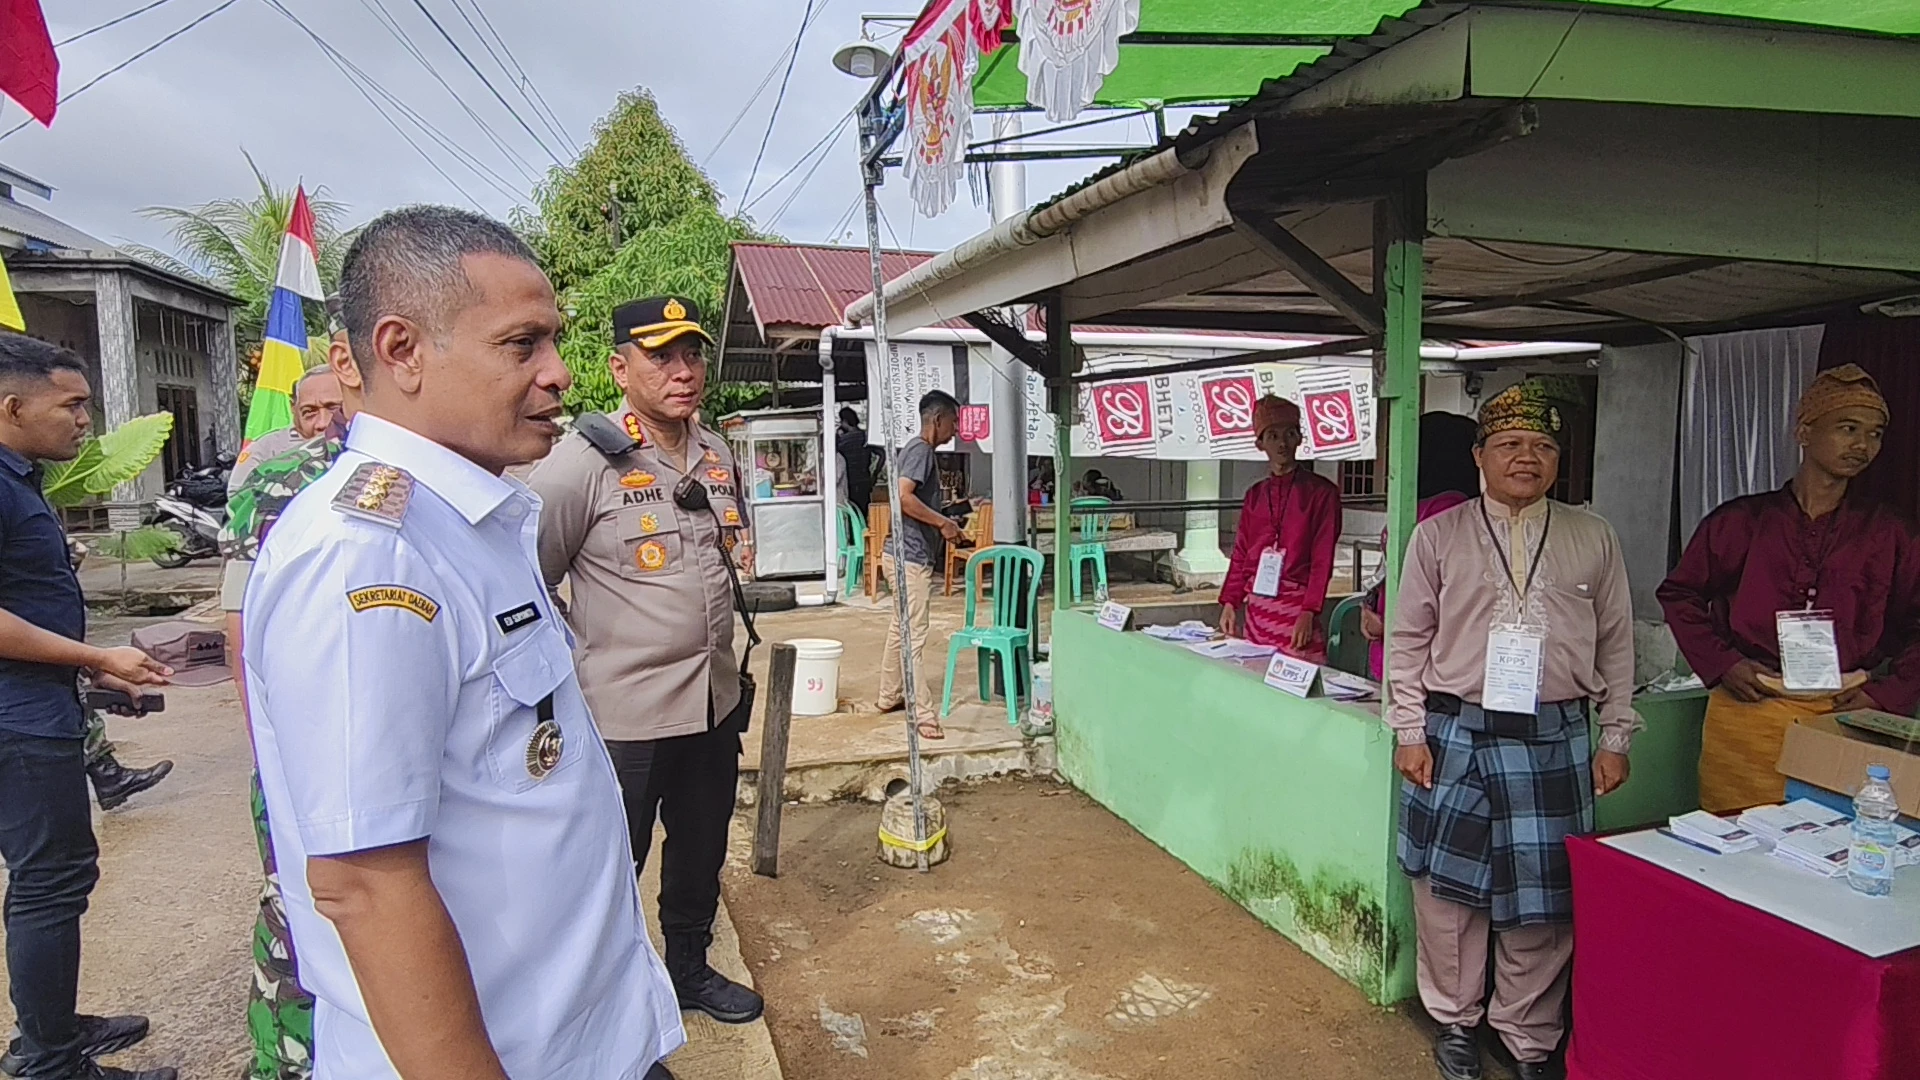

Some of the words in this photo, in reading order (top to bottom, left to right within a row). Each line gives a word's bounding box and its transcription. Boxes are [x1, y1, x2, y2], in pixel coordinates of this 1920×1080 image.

[889, 343, 901, 385] IMPOTENSI
[903, 356, 915, 398] SERANGAN
[892, 386, 902, 402] DAN
[1355, 383, 1371, 441] BHETA
[622, 488, 665, 505] ADHE
[353, 588, 407, 606] SEKRETARIAT
[408, 593, 436, 616] DAERAH
[1499, 655, 1526, 666] KPPS
